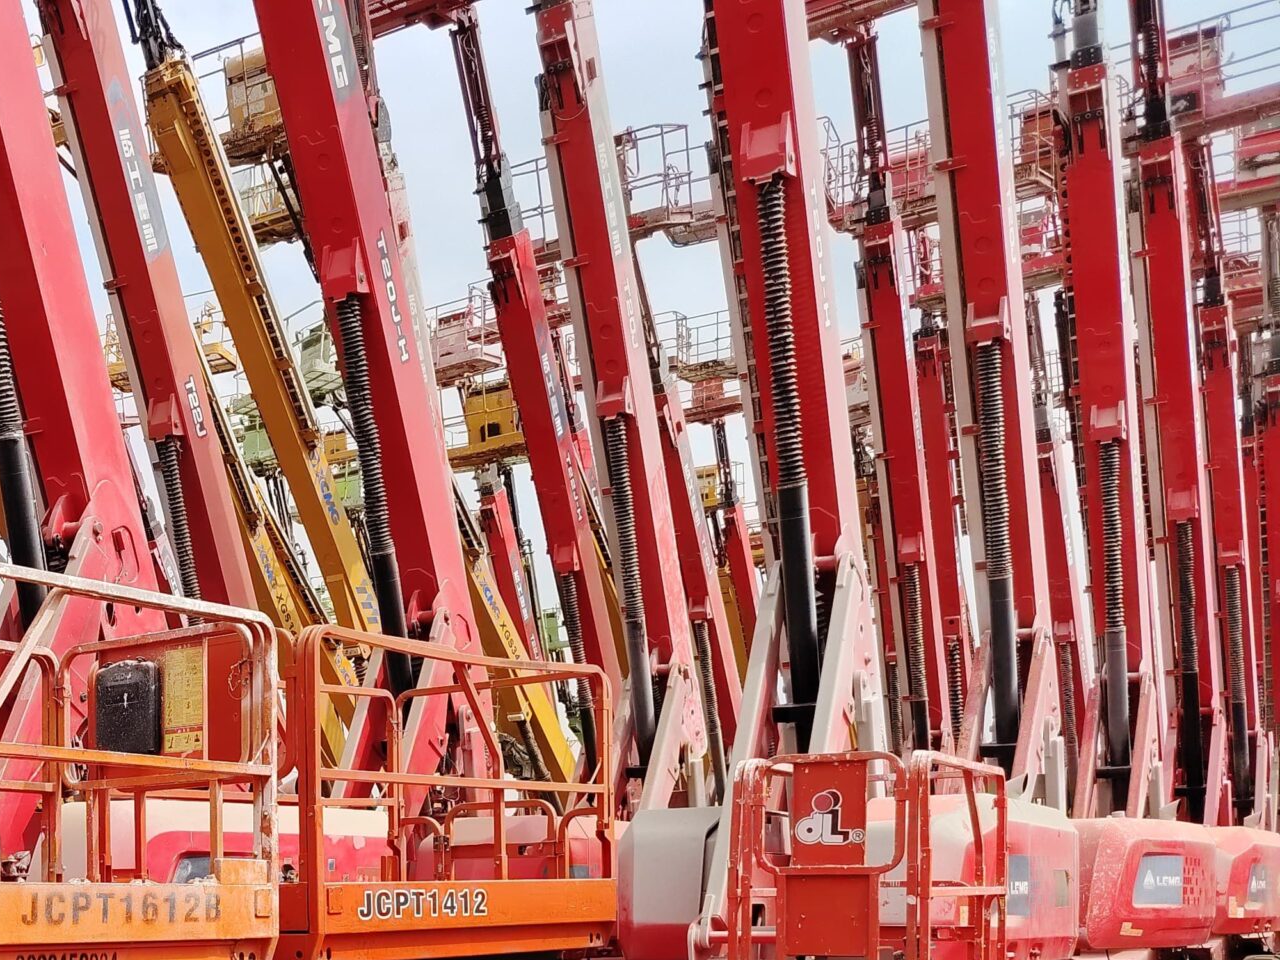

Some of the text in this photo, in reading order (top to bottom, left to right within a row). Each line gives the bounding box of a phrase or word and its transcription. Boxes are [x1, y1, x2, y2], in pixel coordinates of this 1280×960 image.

[118, 128, 159, 252] 临工重机
[374, 229, 409, 365] T20J-H
[184, 375, 209, 439] T22J
[499, 620, 521, 660] XGS34
[20, 891, 221, 926] JCPT1612B
[357, 888, 489, 921] JCPT1412
